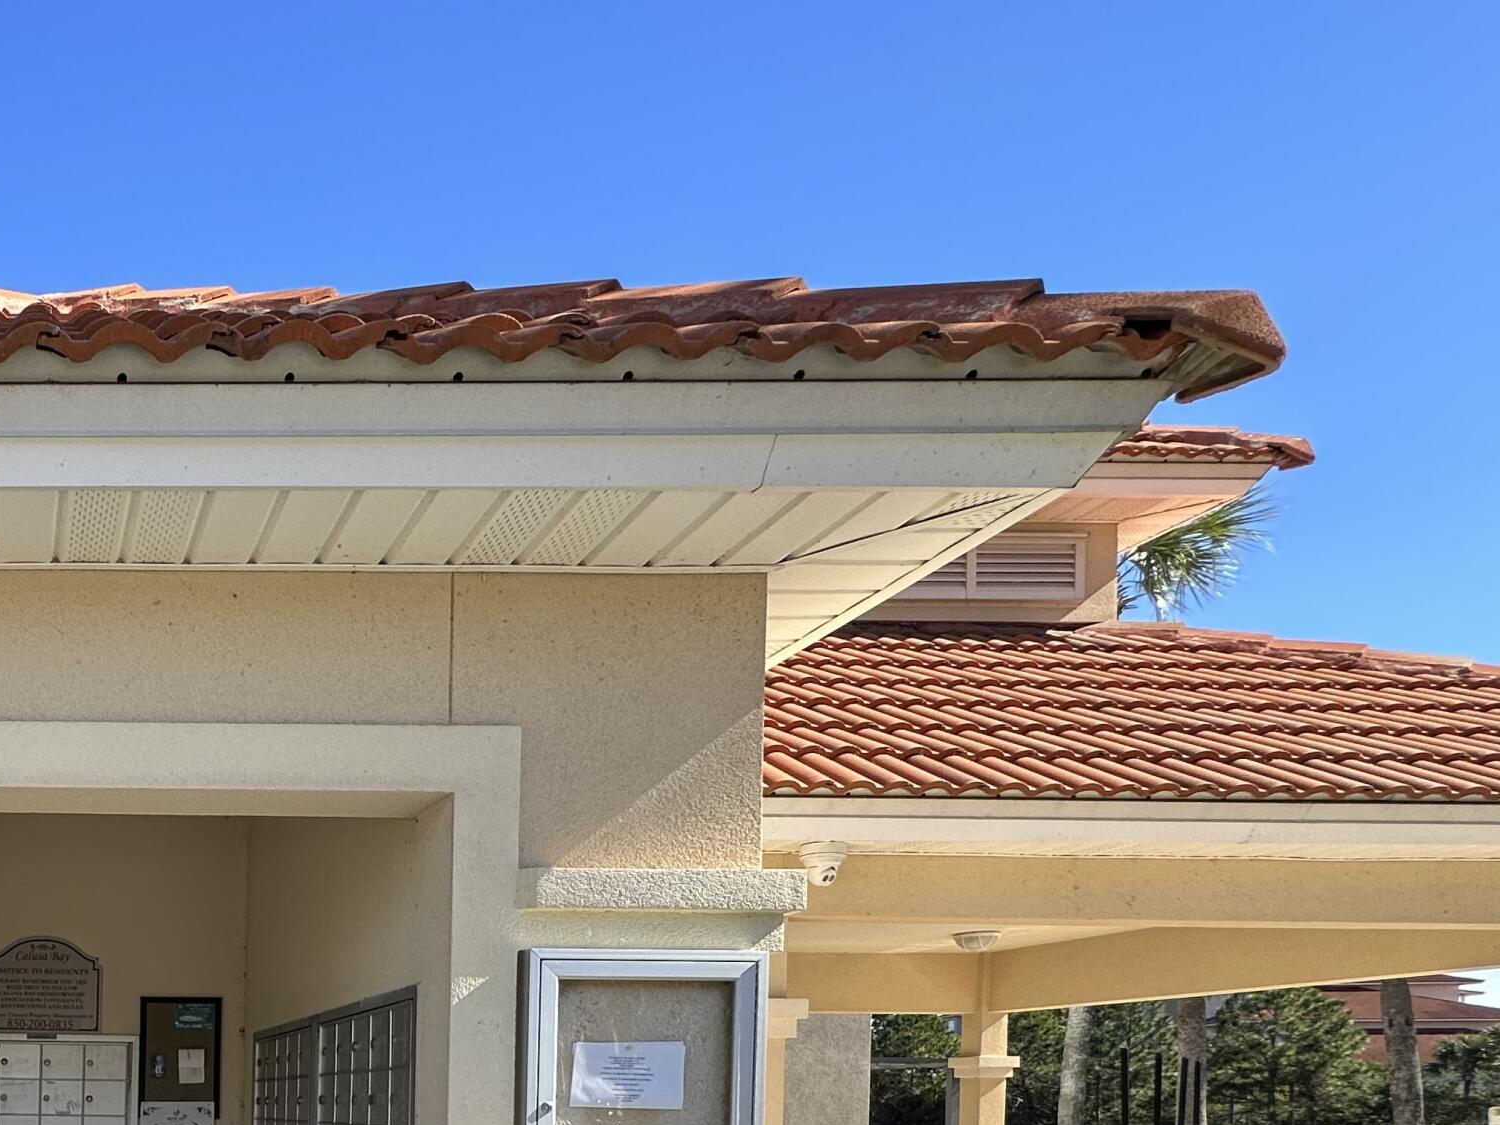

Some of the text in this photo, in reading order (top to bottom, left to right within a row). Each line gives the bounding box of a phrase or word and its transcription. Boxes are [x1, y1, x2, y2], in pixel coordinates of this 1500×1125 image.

[15, 950, 70, 965] Calusa Bay
[32, 967, 43, 975] TO
[7, 1018, 74, 1029] 850-200-0835
